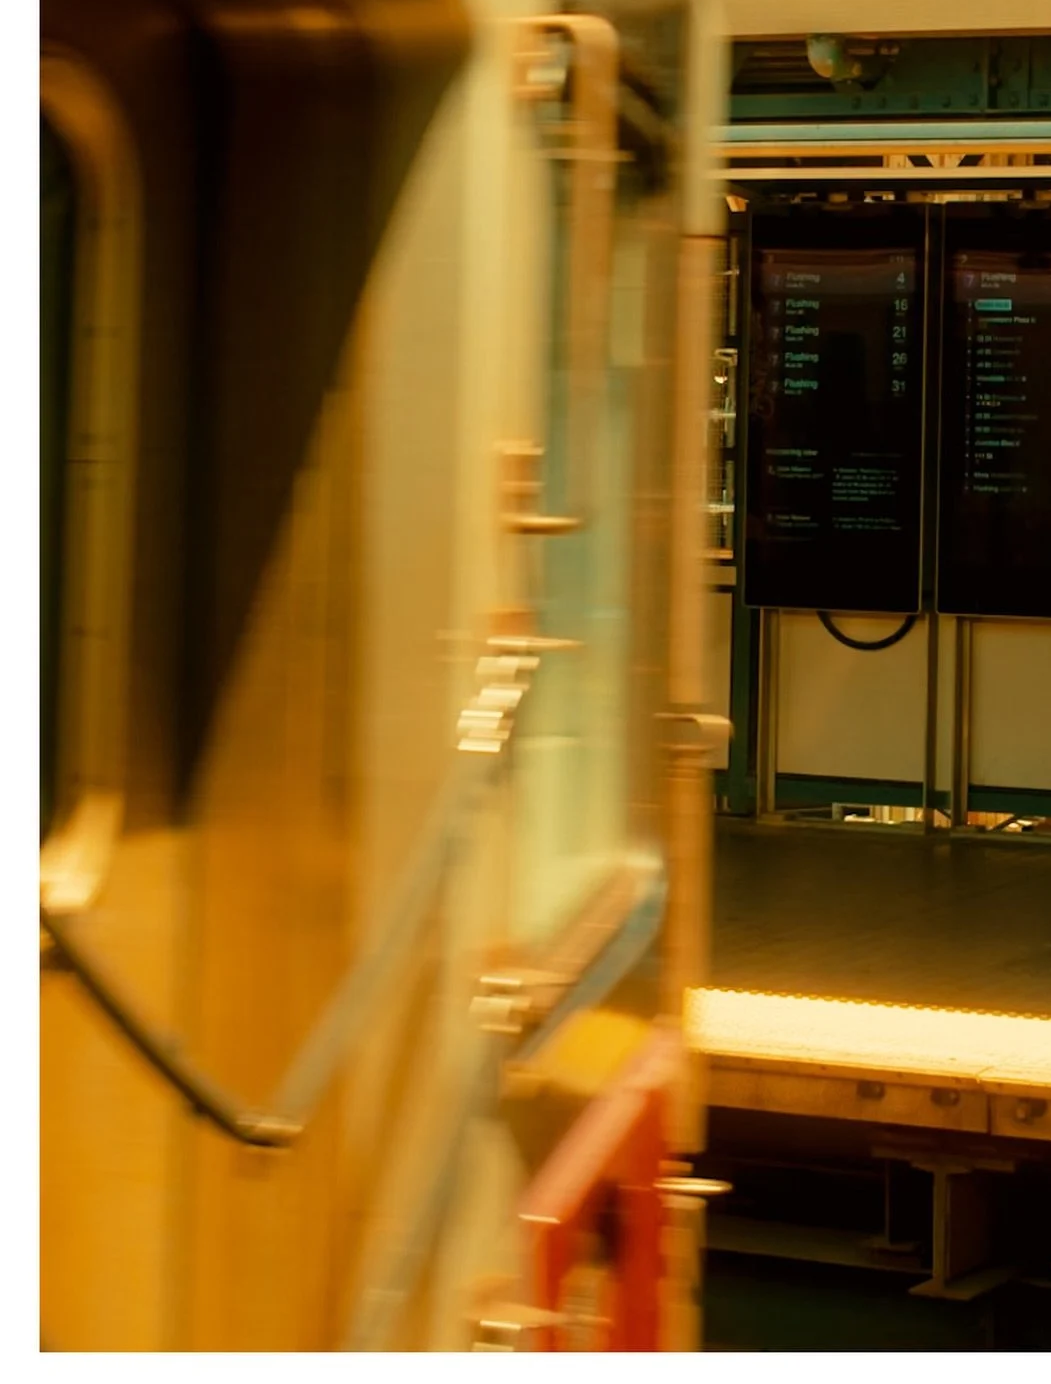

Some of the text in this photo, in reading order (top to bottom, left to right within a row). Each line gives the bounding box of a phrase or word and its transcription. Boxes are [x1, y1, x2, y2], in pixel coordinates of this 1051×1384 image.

[897, 272, 905, 283] 4
[786, 299, 820, 309] Flushing
[894, 299, 908, 311] 16
[785, 326, 820, 336] Flushing
[893, 326, 907, 338] 21
[785, 352, 819, 363] Flushing
[892, 353, 907, 365] 26
[784, 378, 819, 389] Flushing
[892, 380, 906, 392] 31
